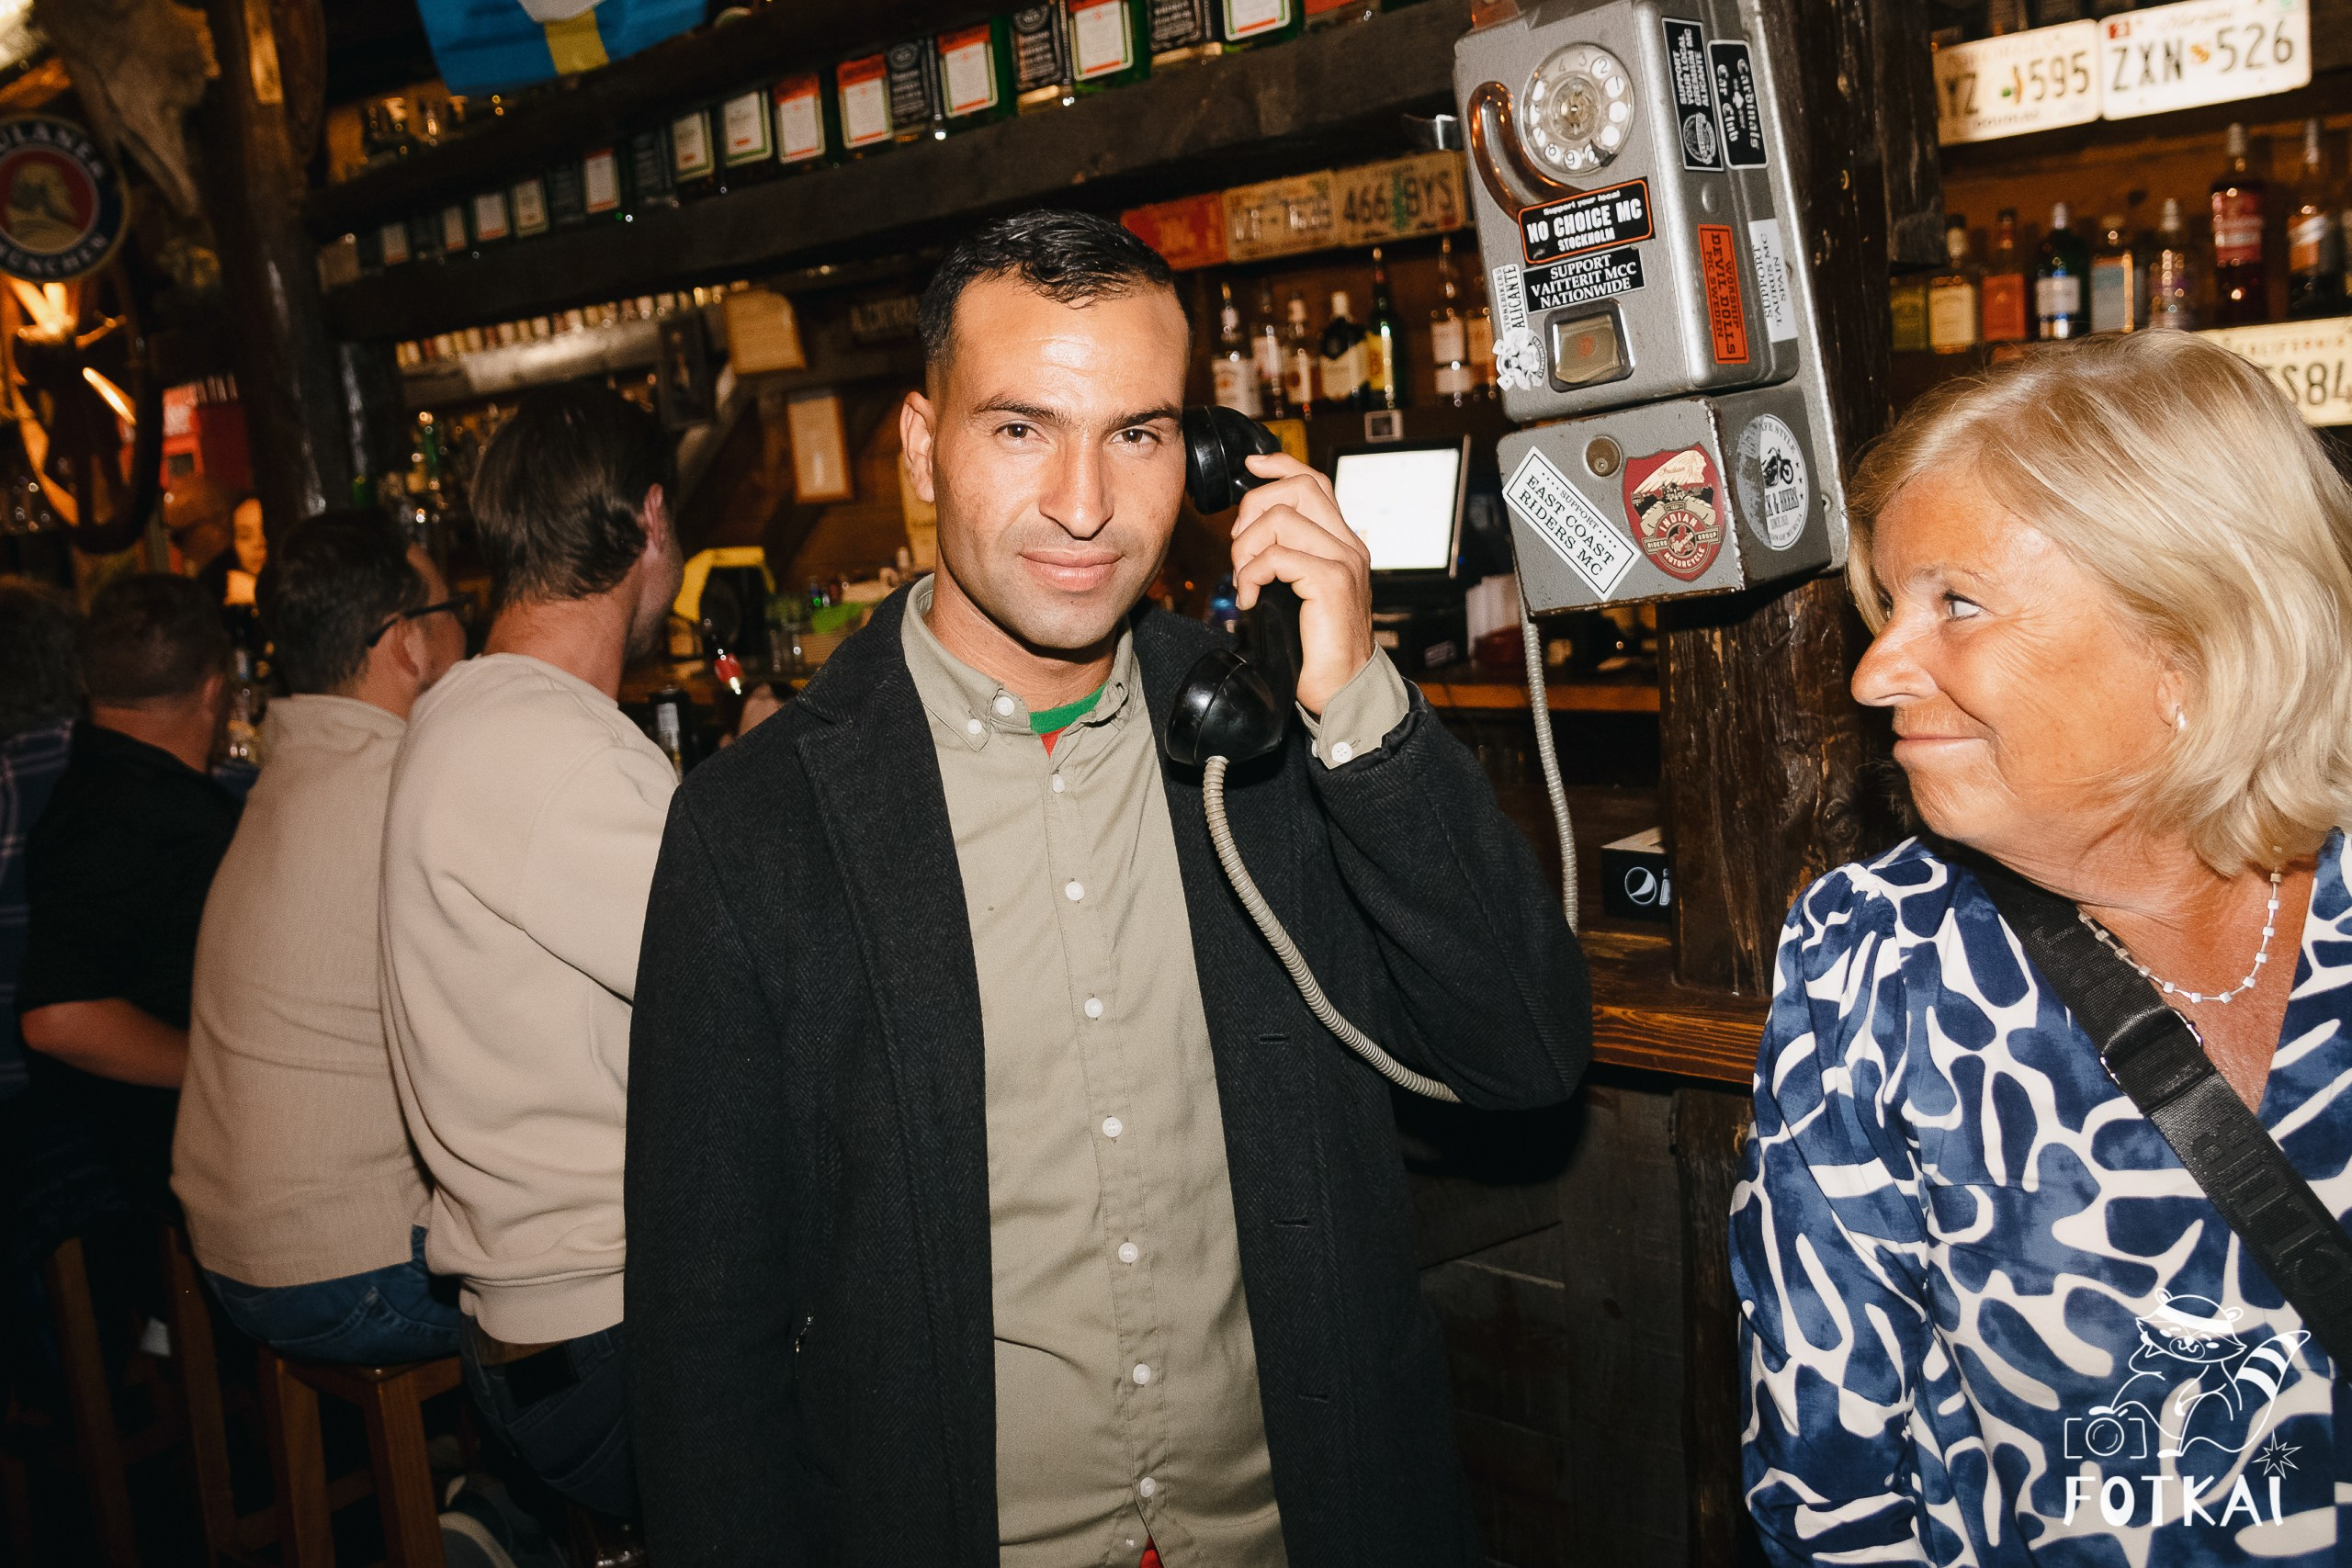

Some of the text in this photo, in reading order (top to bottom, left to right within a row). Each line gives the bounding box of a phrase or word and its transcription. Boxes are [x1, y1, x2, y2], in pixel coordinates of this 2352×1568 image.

[1599, 58, 1608, 73] 2
[1678, 34, 1694, 105] YOUR LOCAL
[2028, 50, 2091, 103] 595
[2111, 37, 2184, 92] ZXN
[2217, 17, 2295, 73] 526
[1673, 51, 1687, 105] SUPPORT
[1695, 51, 1710, 107] ALICANTE
[1717, 64, 1730, 96] Car
[1723, 102, 1739, 142] Club
[1526, 198, 1643, 243] NO CHOICE MC
[1543, 190, 1621, 216] Support your local
[1557, 227, 1615, 252] STOCKHOLM
[1531, 262, 1636, 297] VAITTERIT MCC
[1550, 254, 1611, 280] SUPPORT
[1753, 244, 1772, 318] SUPPORT
[1760, 233, 1782, 326] TAURUS MC
[1773, 256, 1786, 301] SPAIN
[1503, 265, 1525, 329] ALICANTE
[1540, 277, 1632, 309] NATIONWIDE
[1706, 251, 1724, 338] MC SWEDEN
[1711, 233, 1736, 355] DEVIL DOLLS
[1519, 489, 1602, 576] RIDERS MC
[1526, 475, 1614, 565] EAST COAST
[1560, 491, 1599, 530] SUPPORT
[1659, 513, 1698, 532] INDIAN
[1663, 547, 1705, 568] MOTORCYCLE
